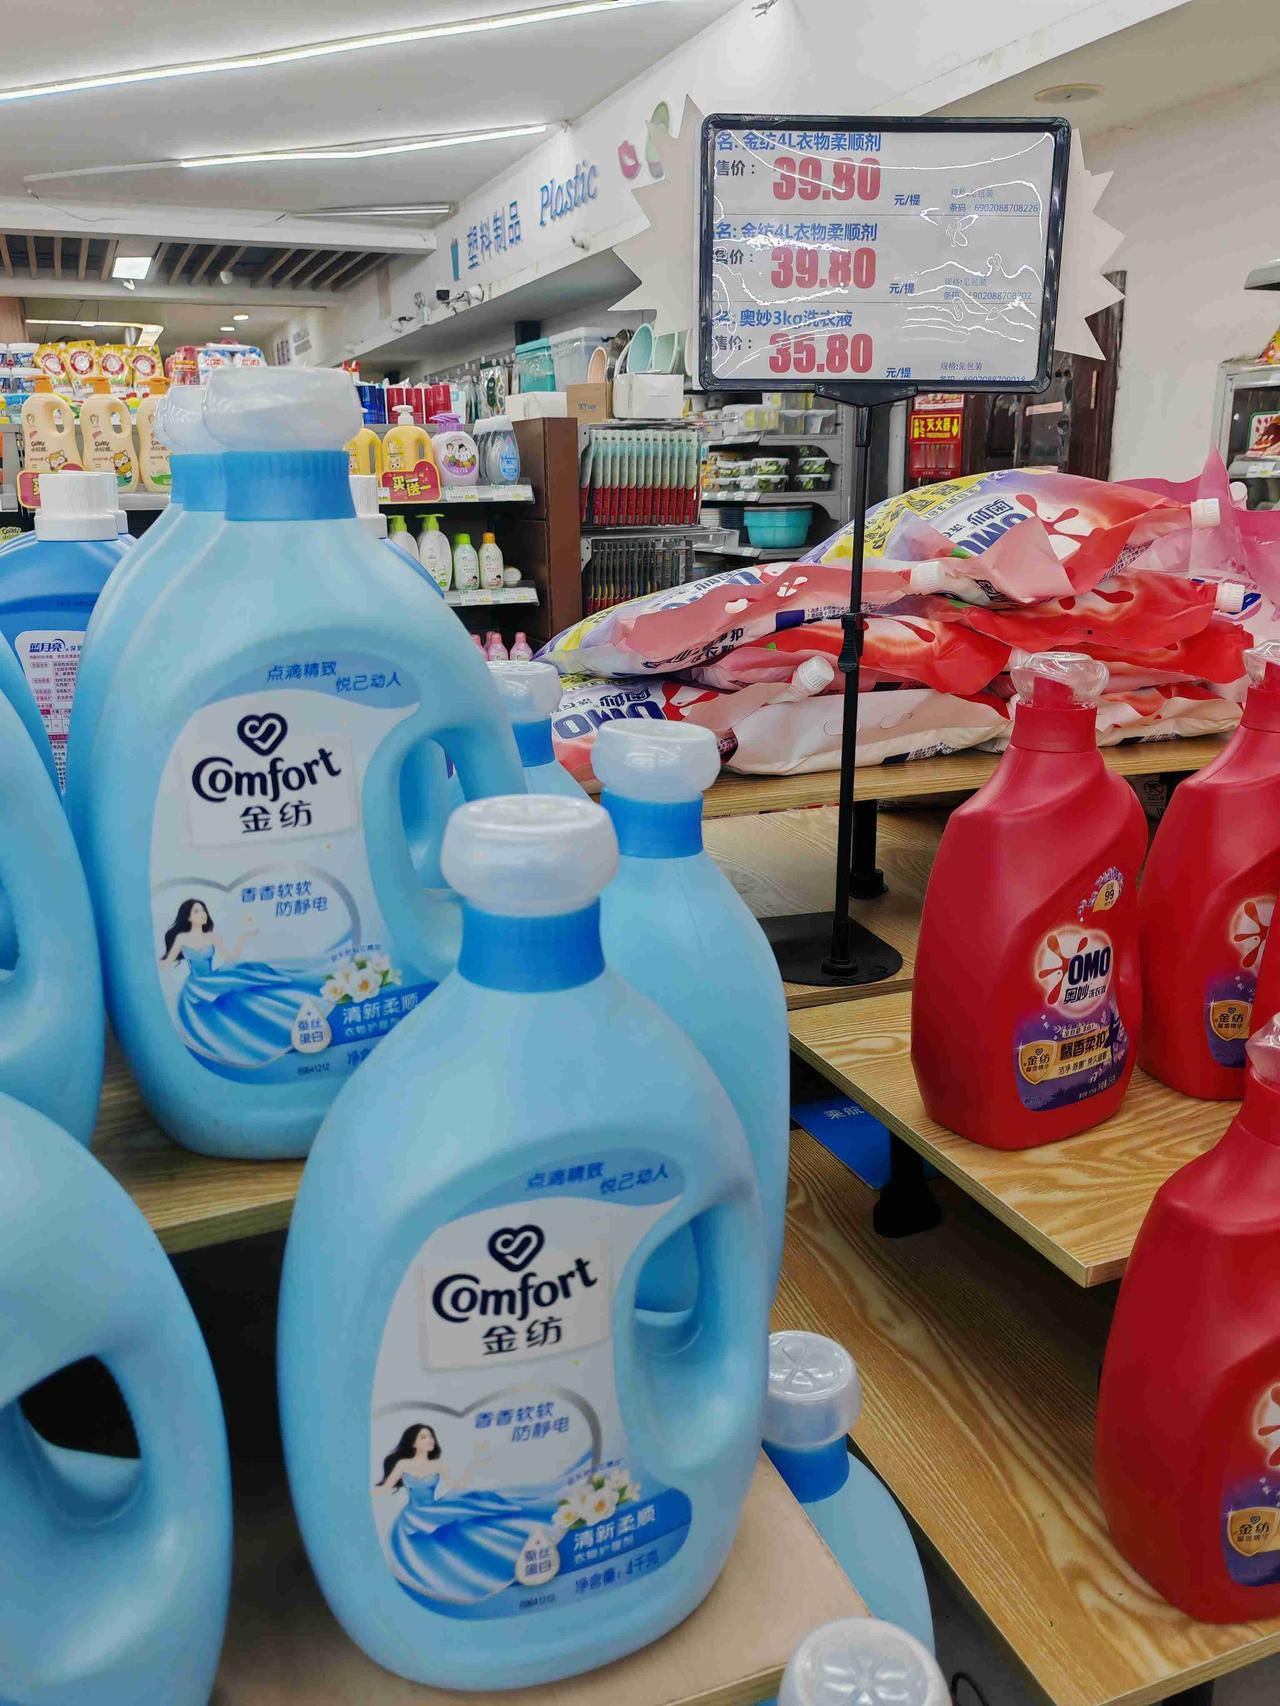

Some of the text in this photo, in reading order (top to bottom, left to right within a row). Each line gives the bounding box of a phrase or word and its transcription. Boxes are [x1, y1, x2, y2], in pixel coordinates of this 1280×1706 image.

[540, 160, 599, 226] Plastic
[773, 156, 881, 201] 39.80
[466, 200, 522, 270] 塑料制品
[770, 247, 877, 289] 39.80
[769, 332, 873, 374] 35.80
[30, 638, 66, 652] 蓝月亮
[266, 660, 338, 681] 点滴精致
[335, 671, 402, 693] 悦己动人
[192, 748, 342, 803] Comfort
[240, 800, 313, 834] 金纺
[240, 880, 313, 904] 香香软软
[274, 896, 329, 918] 防静电
[1068, 946, 1111, 986] OMO
[342, 992, 419, 1025] 清新柔顺
[525, 1161, 605, 1191] 点滴精致
[432, 1257, 598, 1323] Comfort
[482, 1316, 563, 1356] 金纺
[474, 1401, 556, 1430] 香香软软
[511, 1416, 570, 1443] 防静电
[573, 1504, 657, 1552] 清新柔顺
